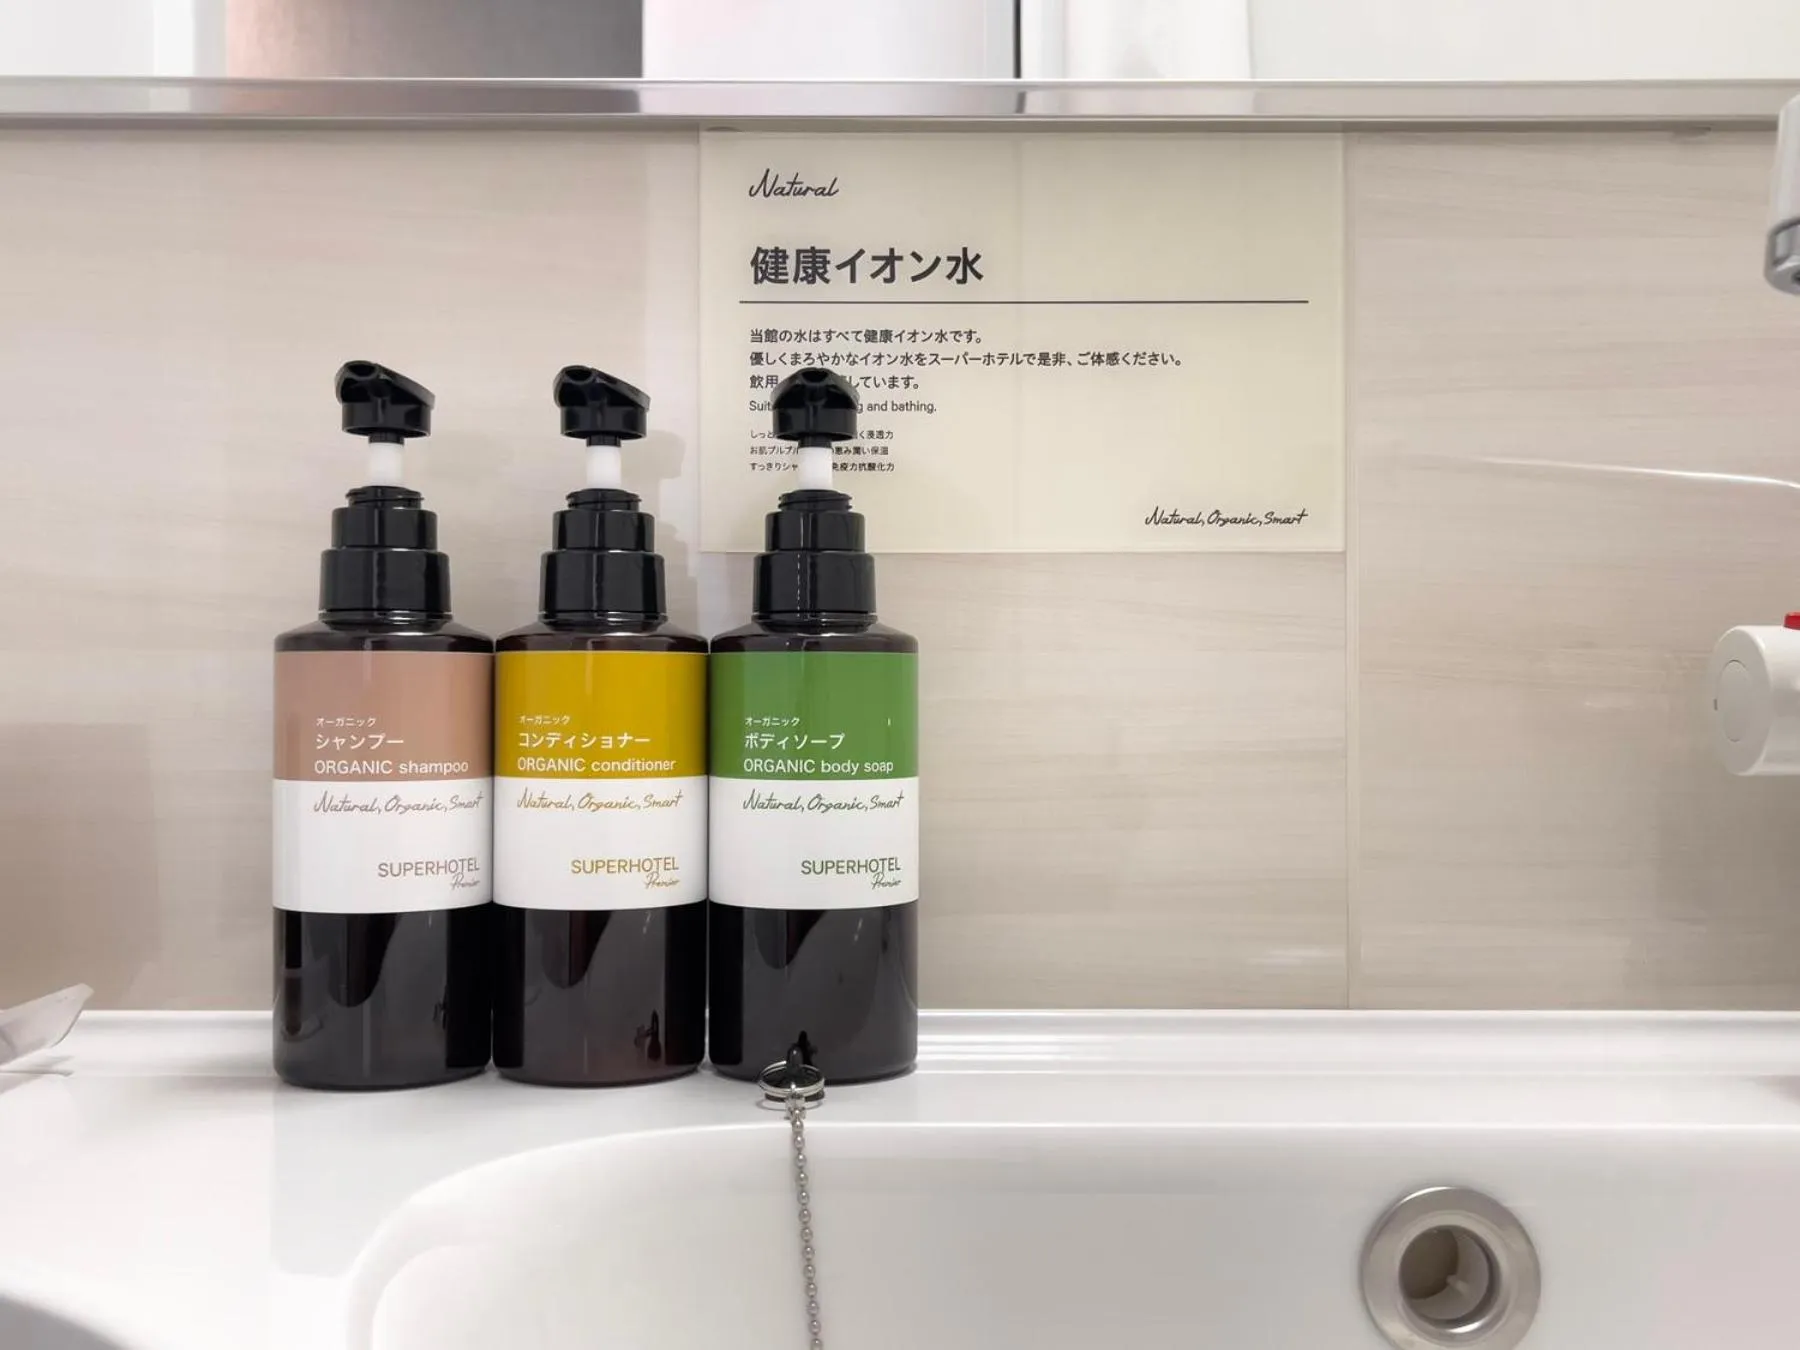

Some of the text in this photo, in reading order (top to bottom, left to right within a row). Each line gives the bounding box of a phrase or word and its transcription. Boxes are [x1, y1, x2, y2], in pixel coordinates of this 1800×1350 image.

[749, 168, 839, 198] Natural
[750, 246, 984, 285] 健康イオン水
[750, 329, 982, 344] 当館の水はすべて健康イオン水です。
[750, 352, 1182, 367] 優しくまろやかなイオン水をスーパーホテルで是非、ご体感ください。
[867, 401, 888, 412] and
[891, 401, 937, 415] bathing.
[1264, 507, 1309, 525] Smart
[316, 717, 377, 728] オーガニック
[520, 715, 571, 726] オーガニック
[745, 717, 800, 727] オーガニック
[316, 733, 404, 751] シャンプー
[519, 732, 651, 749] コンディショナー
[745, 732, 845, 750] ボディソープ
[314, 759, 469, 776] ORGANIC shampoo
[517, 756, 677, 773] ORGANIC conditioner
[743, 758, 894, 776] ORGANIC body soap
[449, 791, 485, 810] Smart
[643, 788, 684, 809] Smart
[869, 789, 905, 810] Smart
[377, 857, 480, 878] SUPERHOTEL
[570, 856, 679, 875] SUPERHOTEL
[800, 857, 901, 875] SUPERHOTEL
